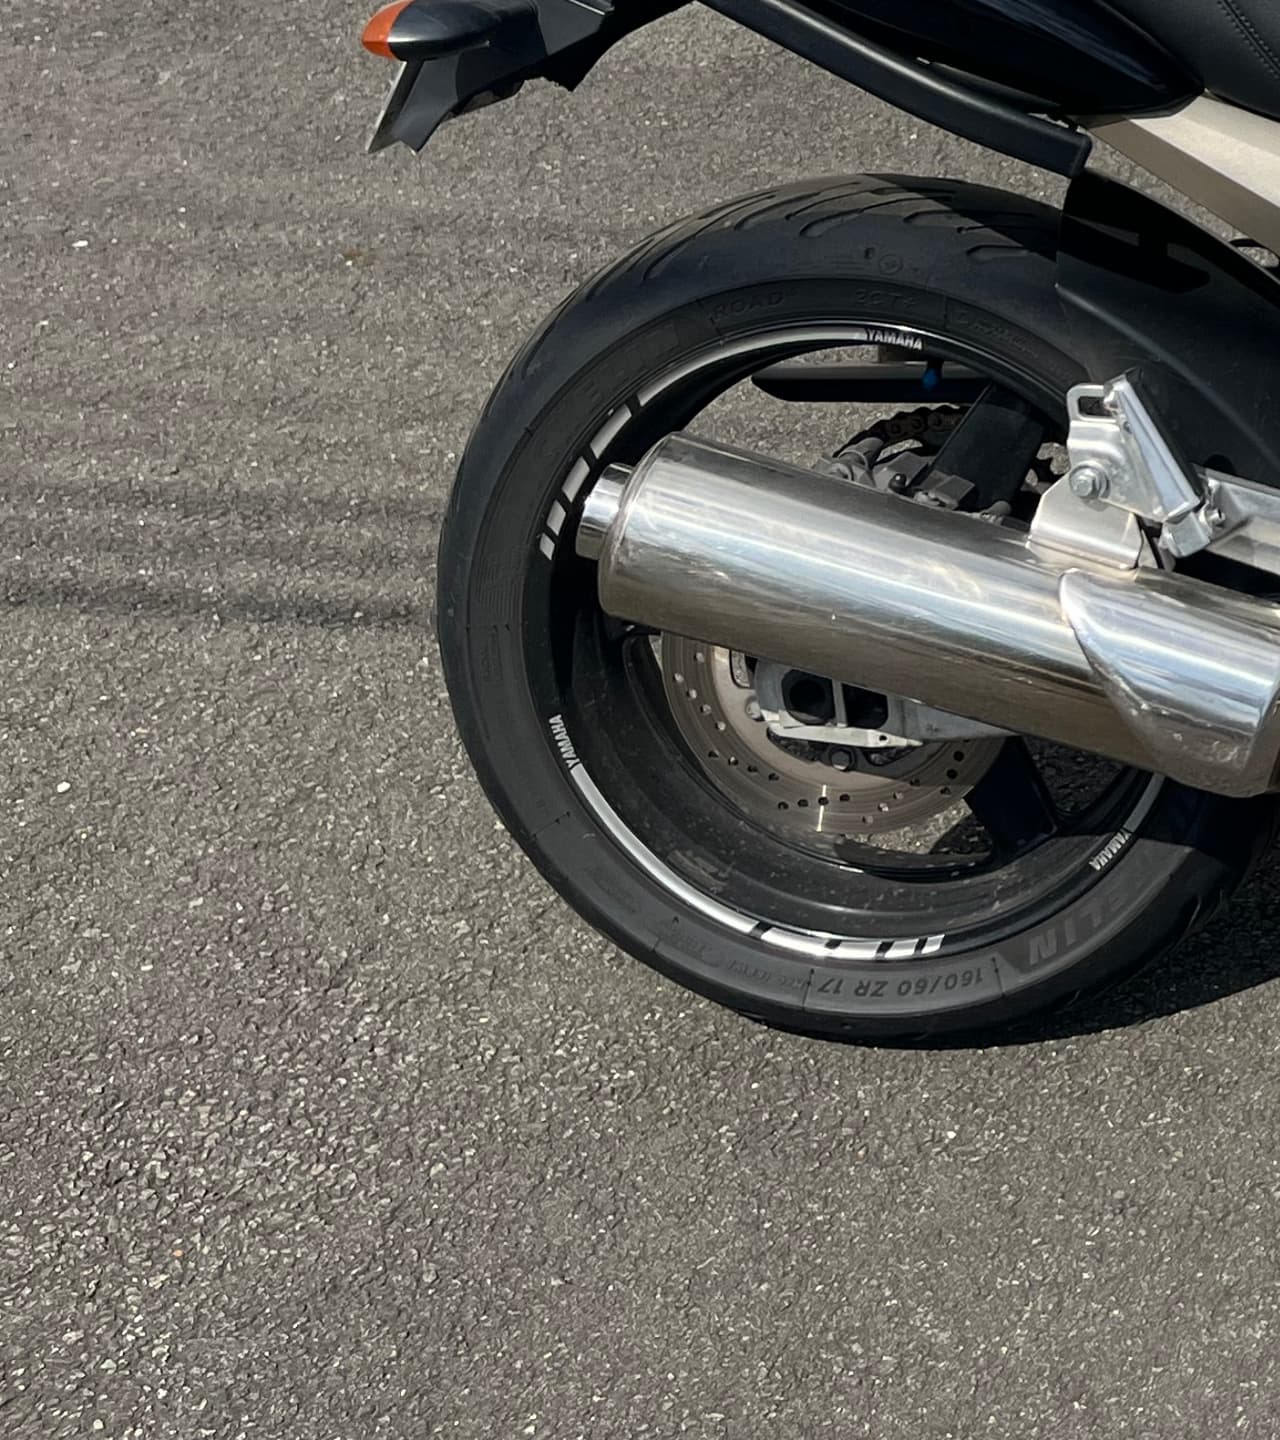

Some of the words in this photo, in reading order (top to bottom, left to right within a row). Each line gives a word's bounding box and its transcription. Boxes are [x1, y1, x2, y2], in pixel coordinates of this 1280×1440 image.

[866, 327, 924, 351] YAMAHA
[548, 713, 585, 770] YAMAHA
[1088, 828, 1134, 872] YAMAHA
[817, 977, 845, 996] 17
[853, 979, 889, 998] ZR
[897, 967, 984, 997] 160/60
